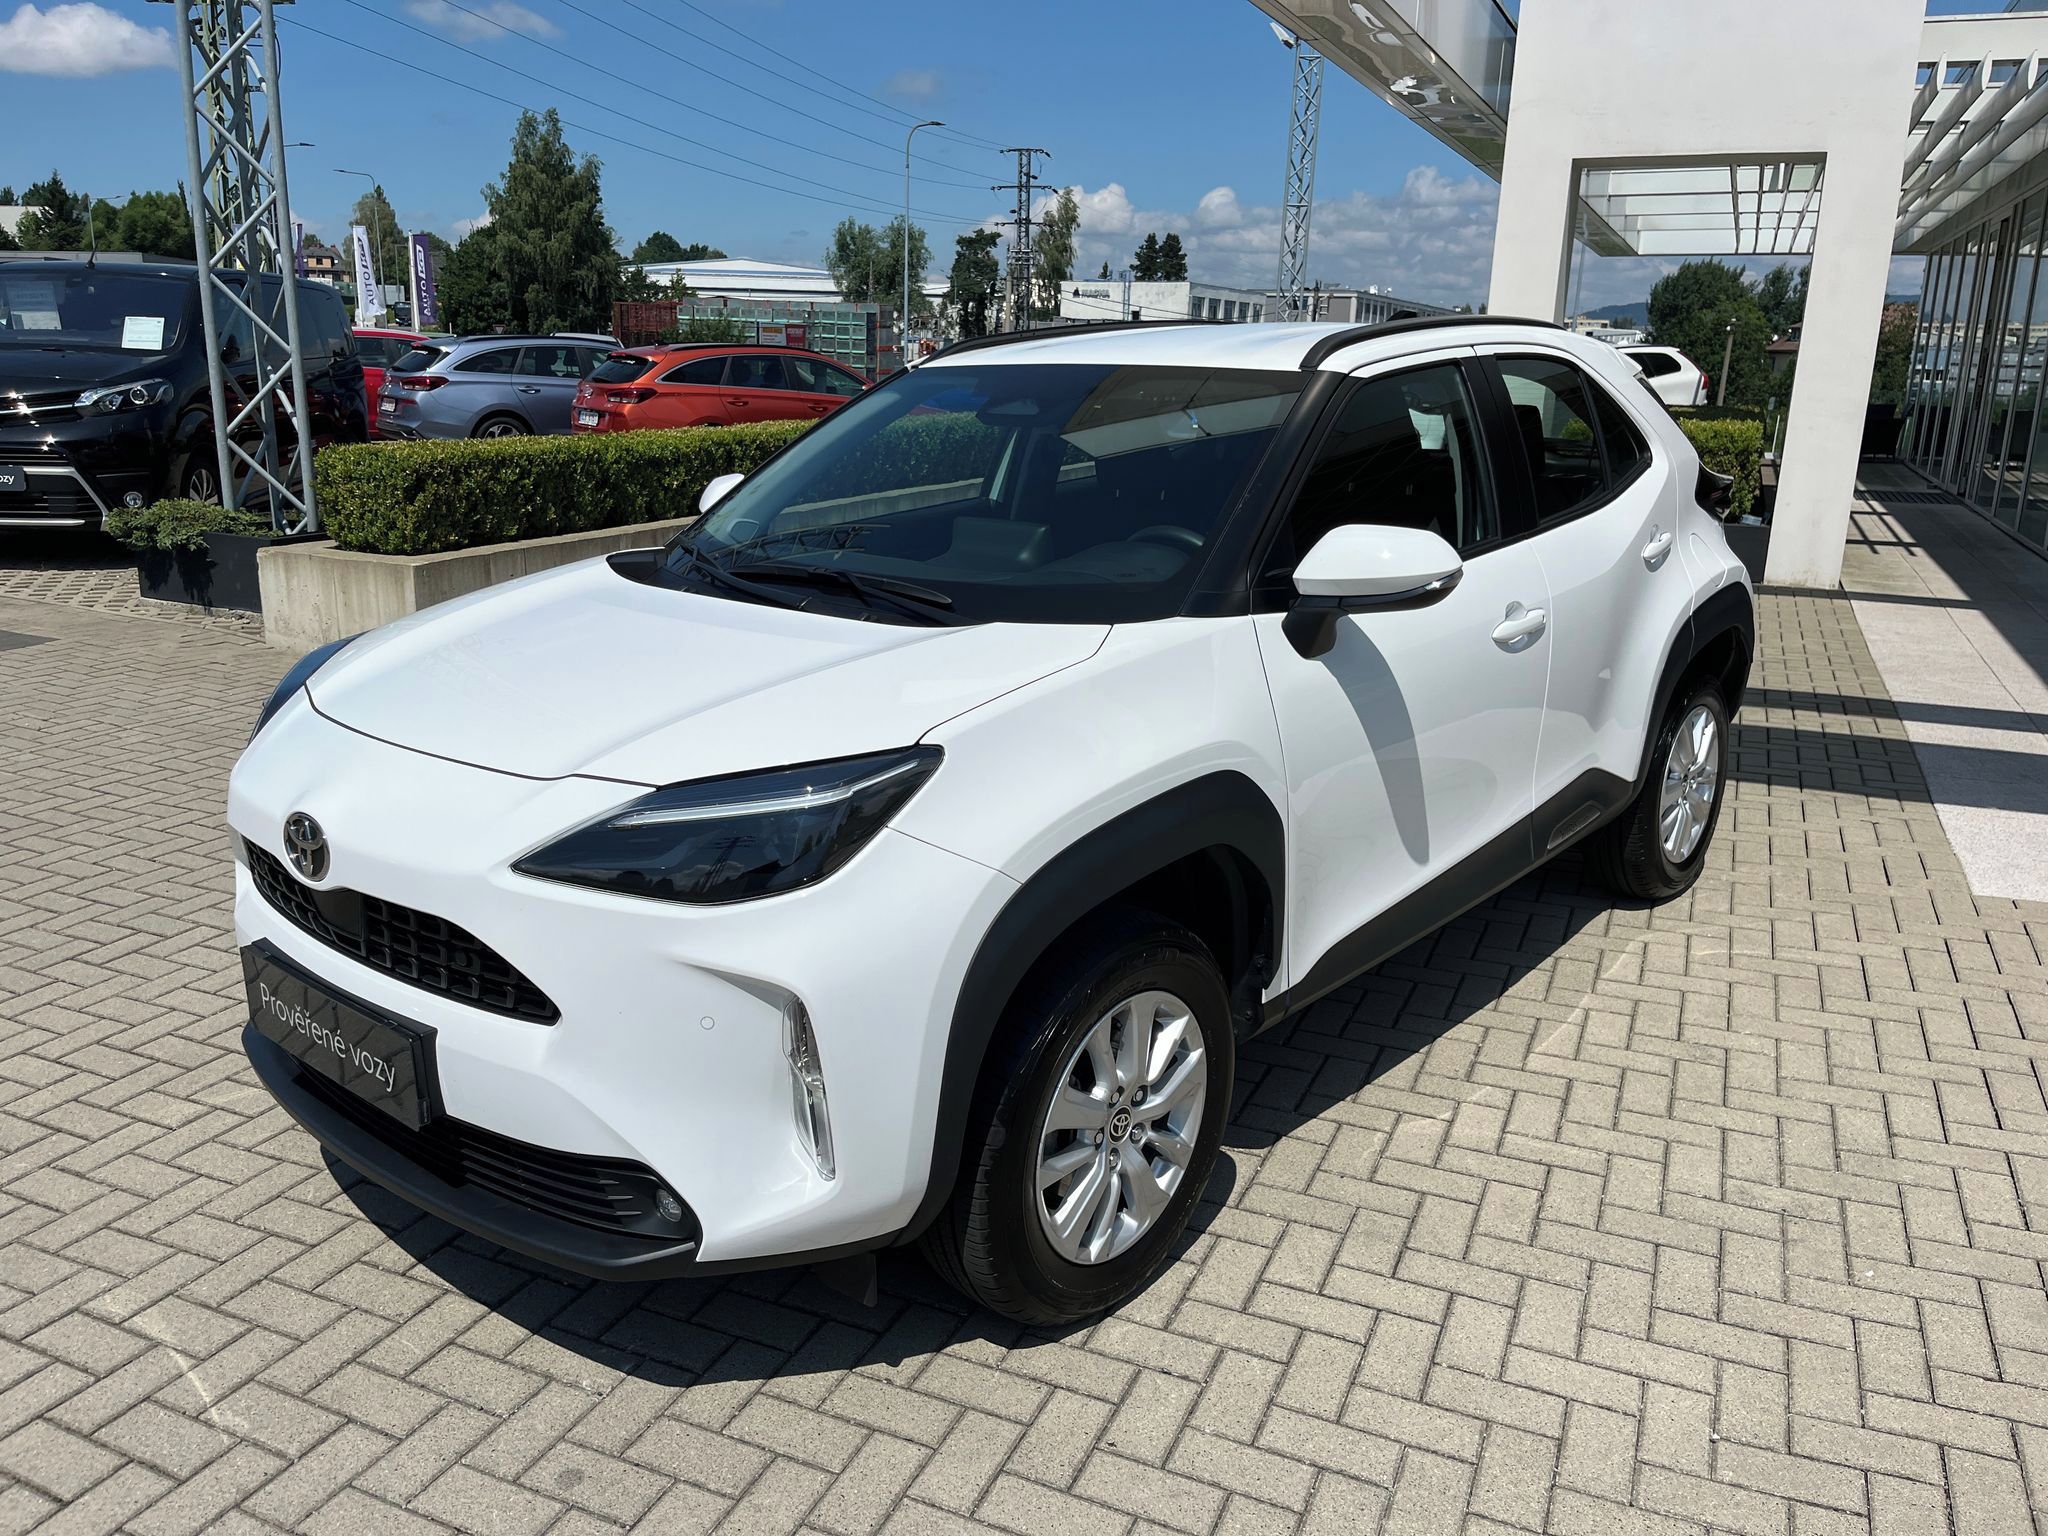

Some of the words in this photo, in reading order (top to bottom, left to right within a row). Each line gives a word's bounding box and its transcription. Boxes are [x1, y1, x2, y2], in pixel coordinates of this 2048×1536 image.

[363, 271, 376, 306] AUTO
[420, 280, 432, 316] AUTO
[260, 982, 346, 1058] Prověřené
[349, 1043, 395, 1092] vozy
